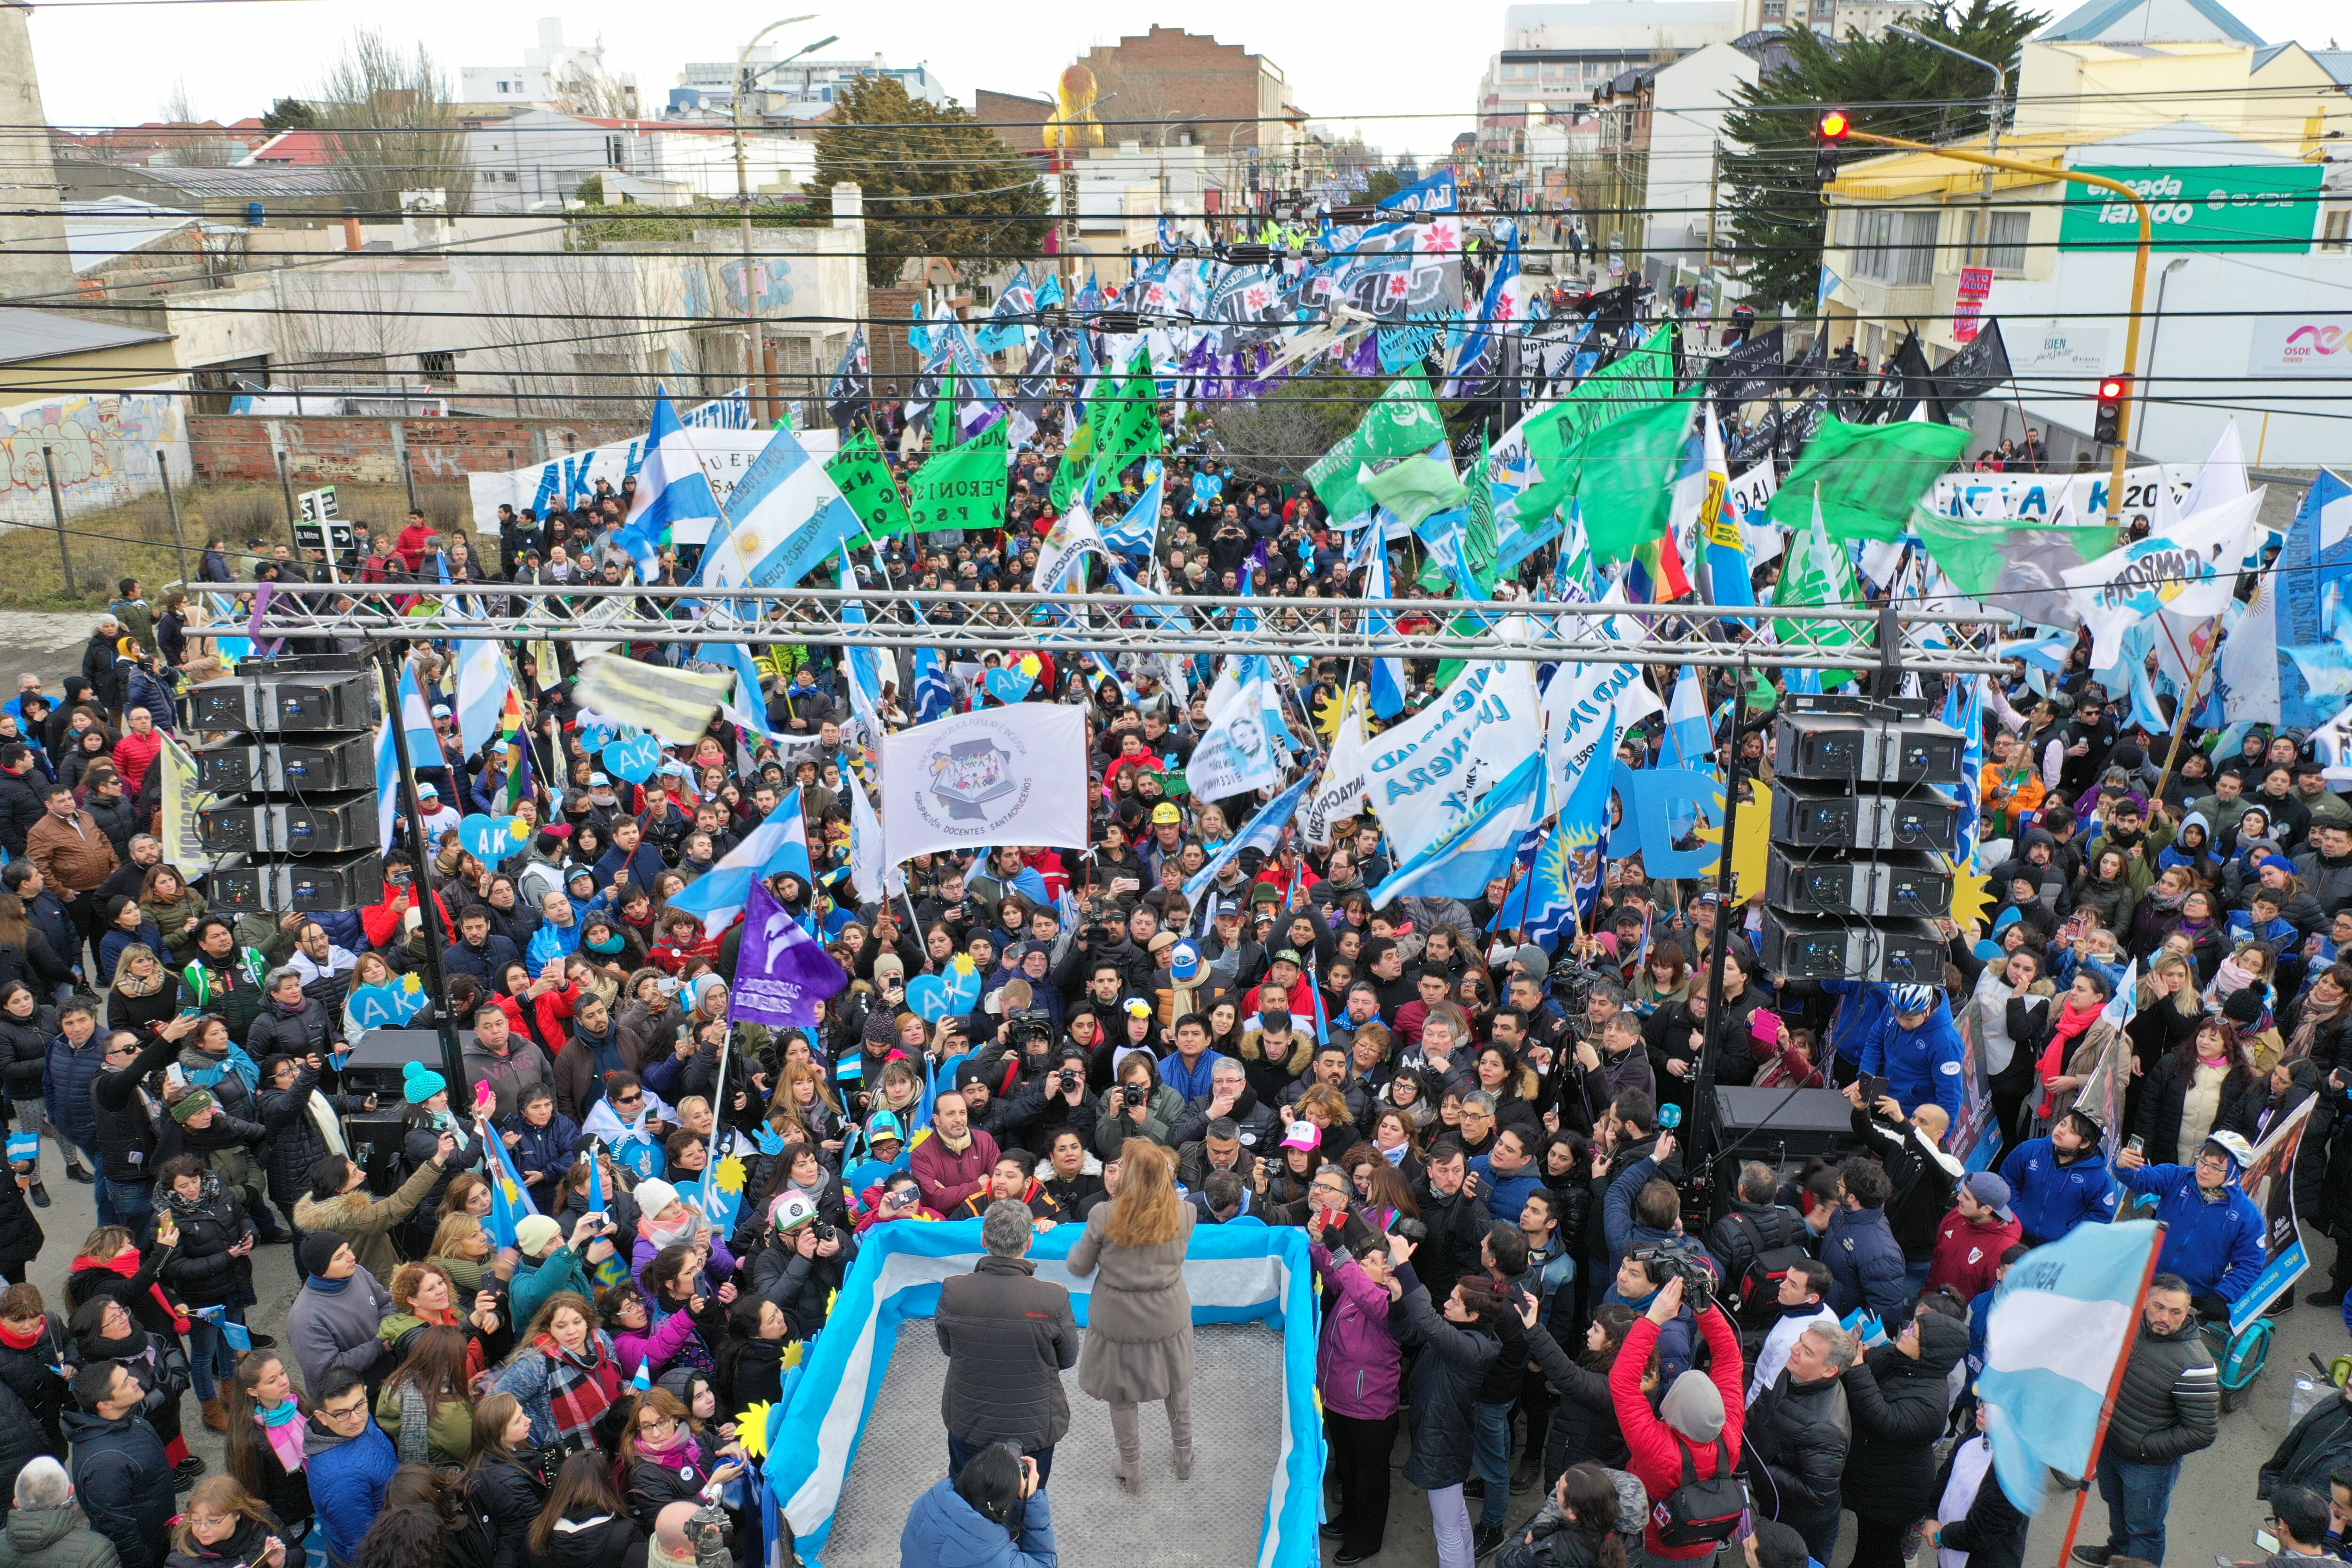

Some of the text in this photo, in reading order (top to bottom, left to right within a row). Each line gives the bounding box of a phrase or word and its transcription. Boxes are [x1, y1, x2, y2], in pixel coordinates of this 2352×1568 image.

[1963, 272, 1988, 282] PATO
[2044, 338, 2066, 350] BIEN
[531, 450, 596, 522] AK
[1196, 478, 1219, 492] AK
[997, 669, 1029, 693] AK
[620, 740, 658, 774] AK
[917, 735, 944, 771] EDUCACIÓN
[969, 718, 999, 729] POPULAR
[1003, 727, 1027, 757] INCLUSIVA
[914, 777, 1032, 836] AGRUPACIÓN DOCENTES SANTACRUCEÑOS
[478, 828, 508, 854] AK
[366, 990, 418, 1025] AK
[480, 1052, 536, 1080] VANS
[1401, 1055, 1424, 1072] AK
[2234, 1297, 2251, 1315] ACUERDO
